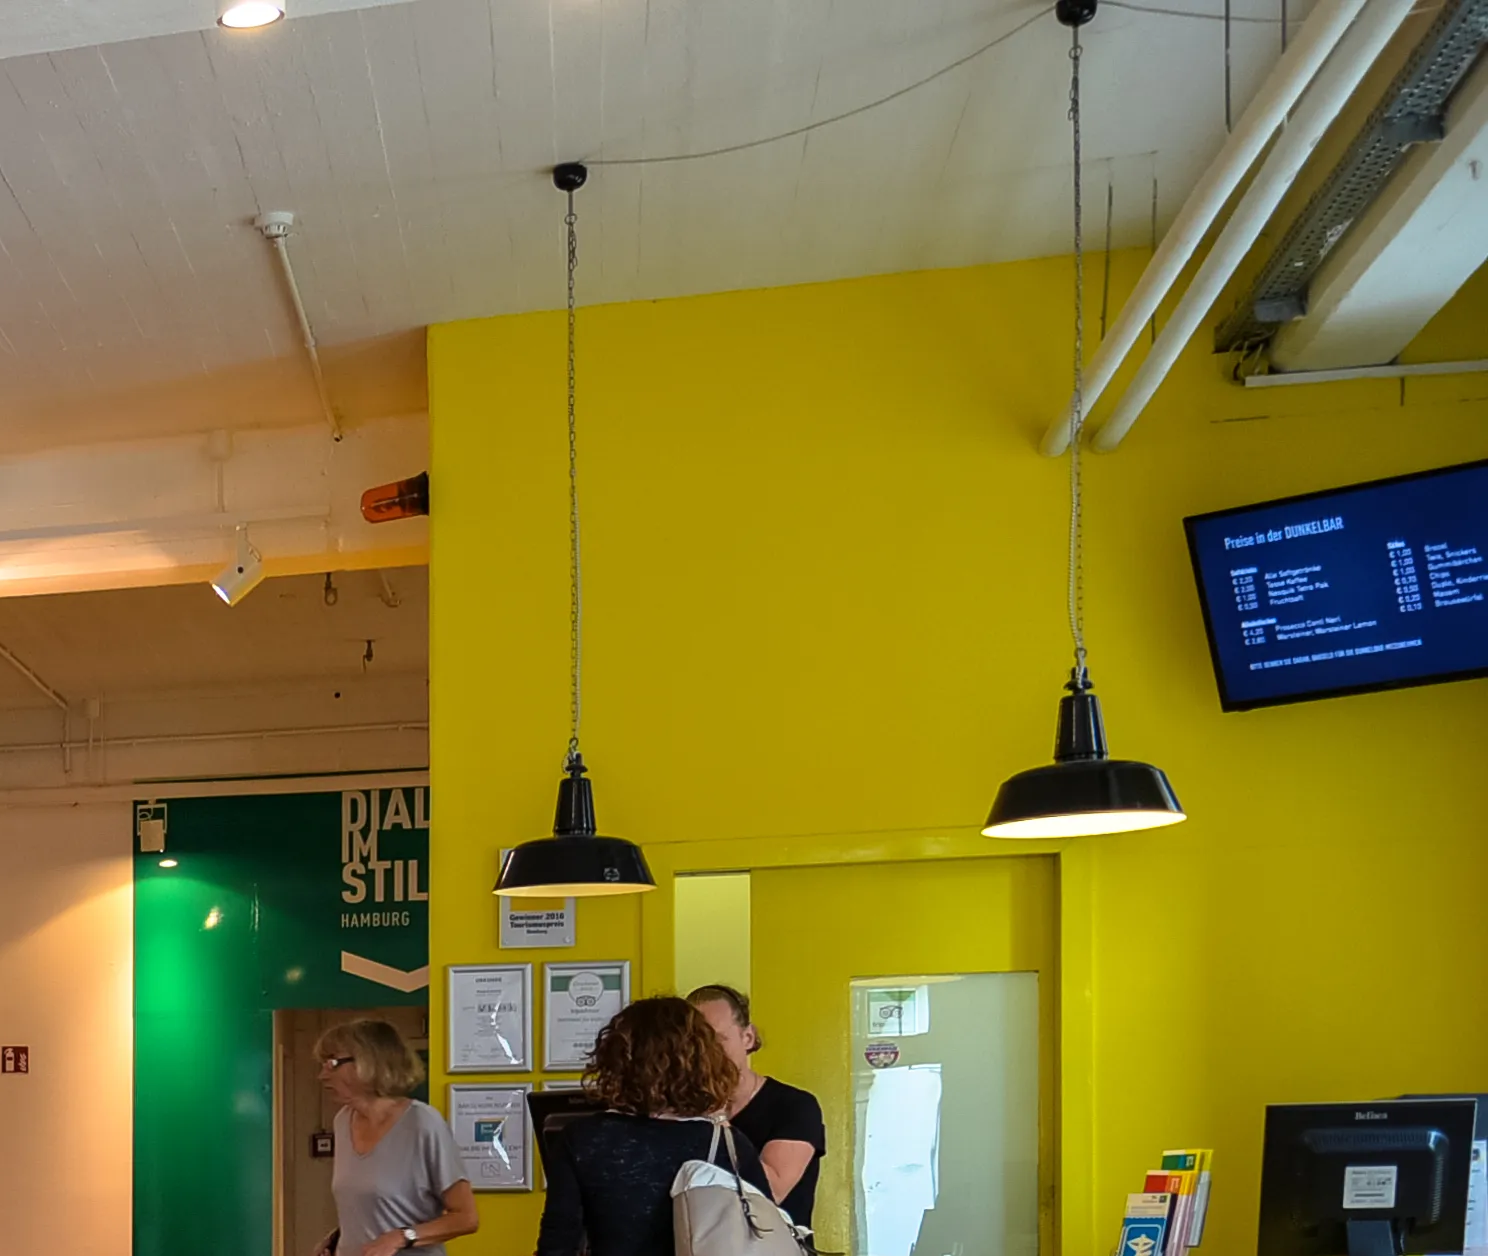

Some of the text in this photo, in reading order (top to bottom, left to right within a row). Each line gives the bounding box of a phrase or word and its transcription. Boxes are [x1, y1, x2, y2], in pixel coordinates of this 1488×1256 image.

[1224, 517, 1344, 550] Preise in der DUNKELBAR
[342, 829, 378, 863] IM
[342, 860, 428, 903] STIL
[341, 911, 410, 928] HAMBURG
[510, 921, 565, 929] Tourismuspreis
